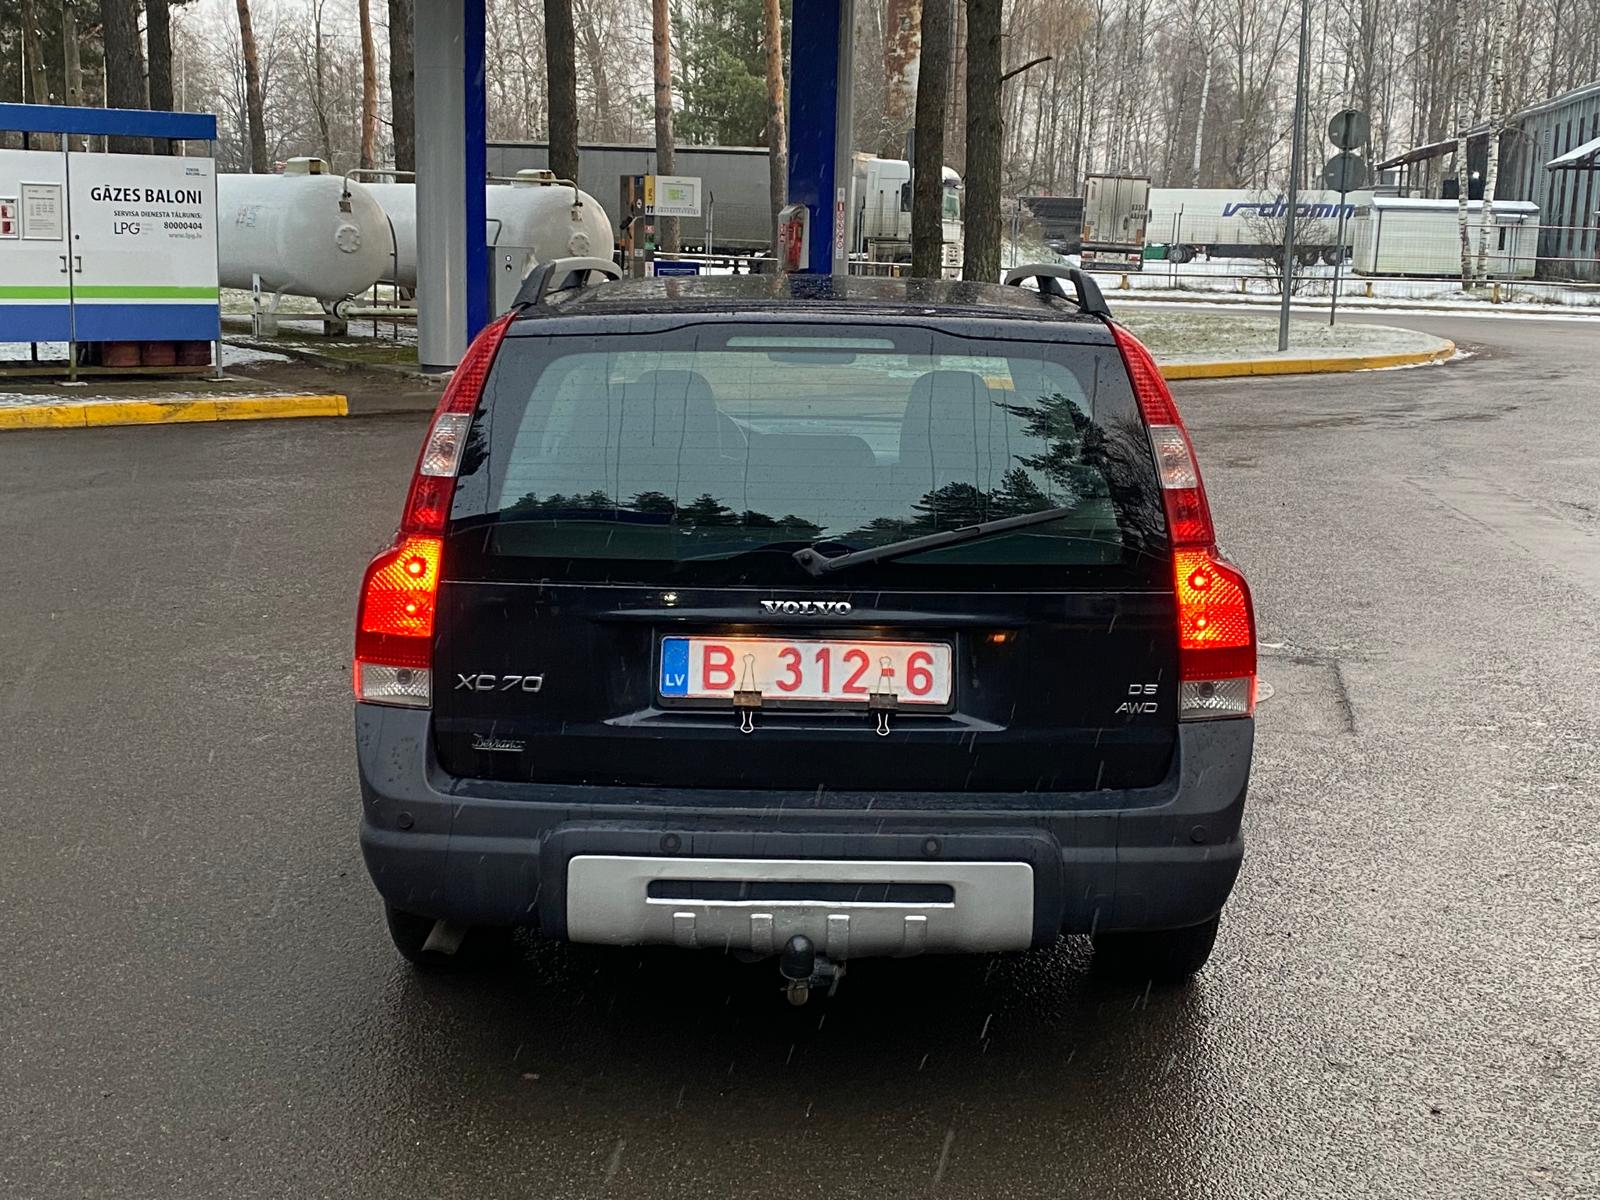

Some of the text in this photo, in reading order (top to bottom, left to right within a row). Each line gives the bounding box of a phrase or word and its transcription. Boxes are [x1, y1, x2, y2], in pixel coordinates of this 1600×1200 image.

[90, 184, 202, 204] GĀZES BALONI
[113, 221, 141, 235] LPG
[163, 221, 203, 230] 80000404
[760, 600, 852, 616] VOLVO
[665, 674, 685, 687] LV
[1128, 684, 1159, 695] D5
[1114, 702, 1158, 714] AWD
